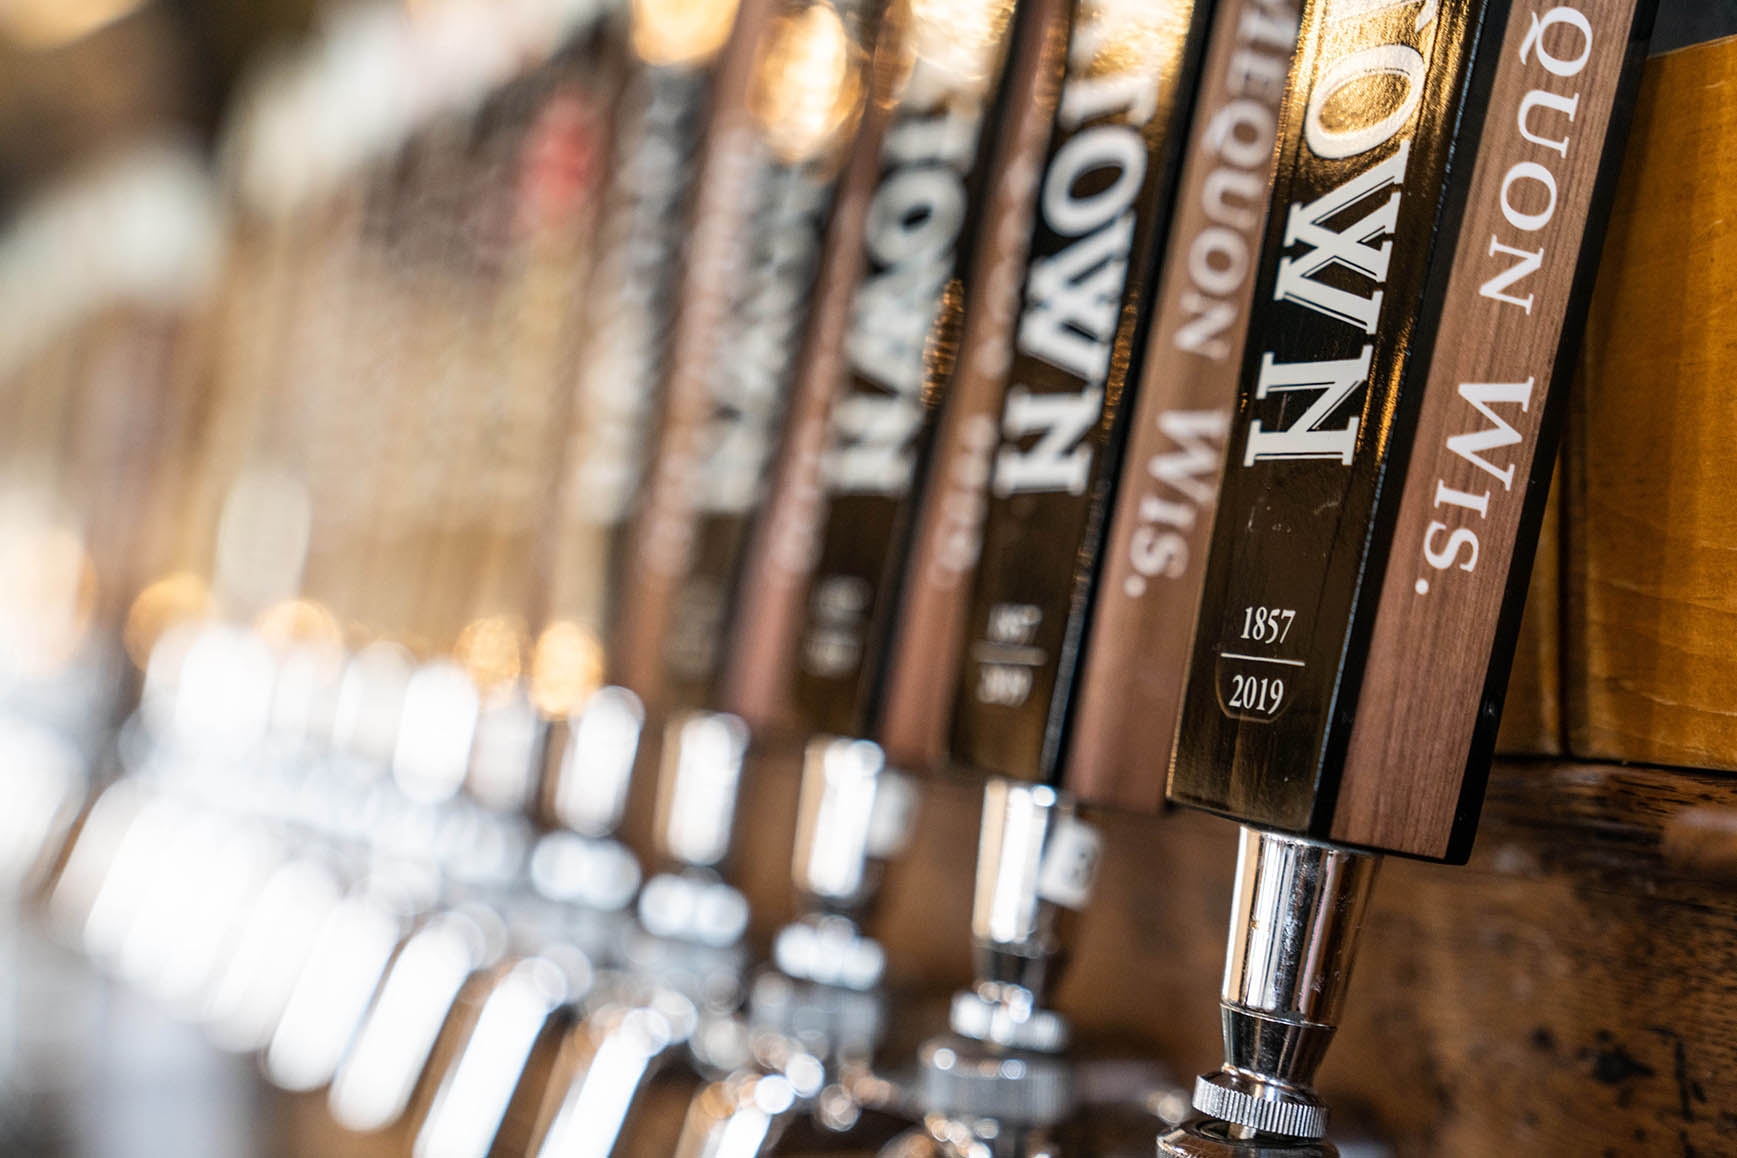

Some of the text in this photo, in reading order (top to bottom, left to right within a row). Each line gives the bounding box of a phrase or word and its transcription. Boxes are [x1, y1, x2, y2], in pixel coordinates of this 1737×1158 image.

[822, 55, 982, 494] TOWN
[995, 0, 1160, 497] TOWN
[1415, 6, 1593, 595] QUON WIS.
[1228, 674, 1285, 715] 2019
[1240, 606, 1296, 645] 1857
